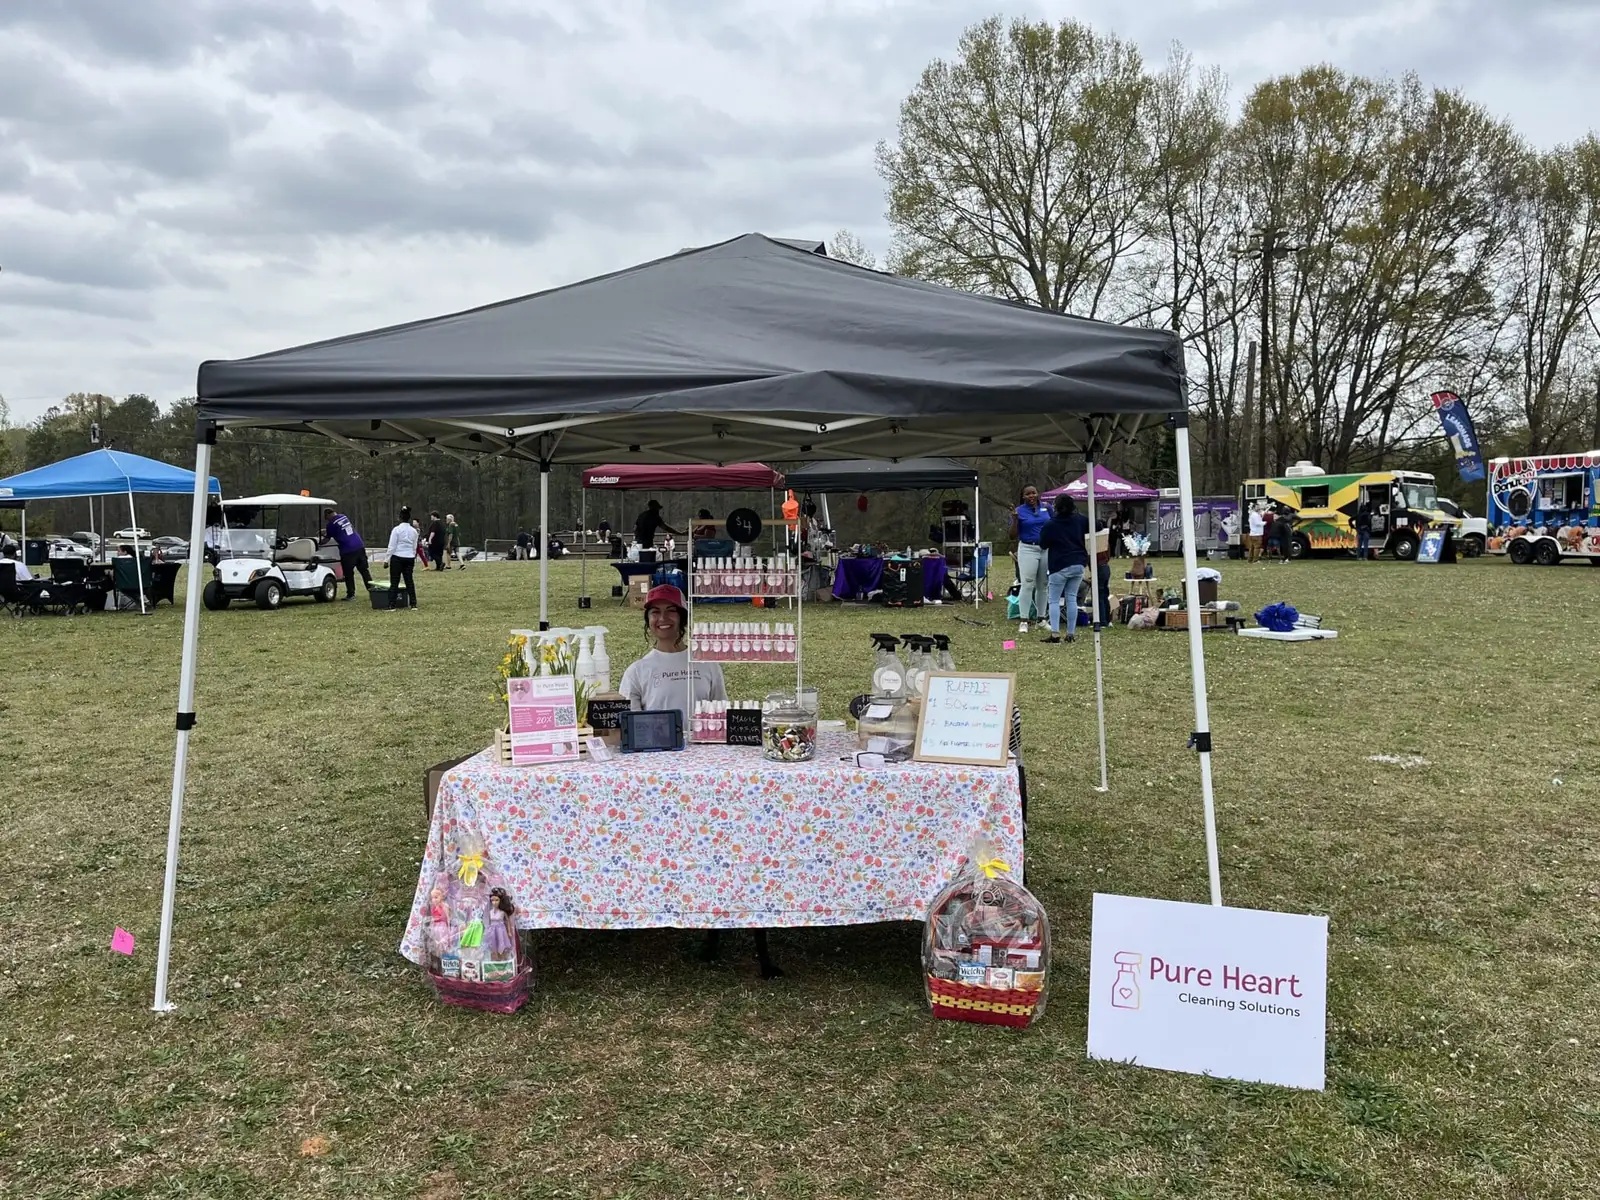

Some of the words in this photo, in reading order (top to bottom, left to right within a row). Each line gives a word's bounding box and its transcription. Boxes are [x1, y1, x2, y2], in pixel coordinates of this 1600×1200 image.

[1445, 413, 1473, 449] LEMONADE
[589, 475, 620, 484] Academy
[736, 515, 753, 536] $4
[1160, 513, 1201, 531] Pudg
[592, 712, 619, 720] CLEAN
[601, 719, 617, 728] $15
[960, 967, 985, 976] Welch's
[1149, 956, 1213, 987] Pure
[1222, 964, 1303, 998] Heart
[1178, 992, 1236, 1011] Cleaning
[1239, 1000, 1301, 1018] Solutions
